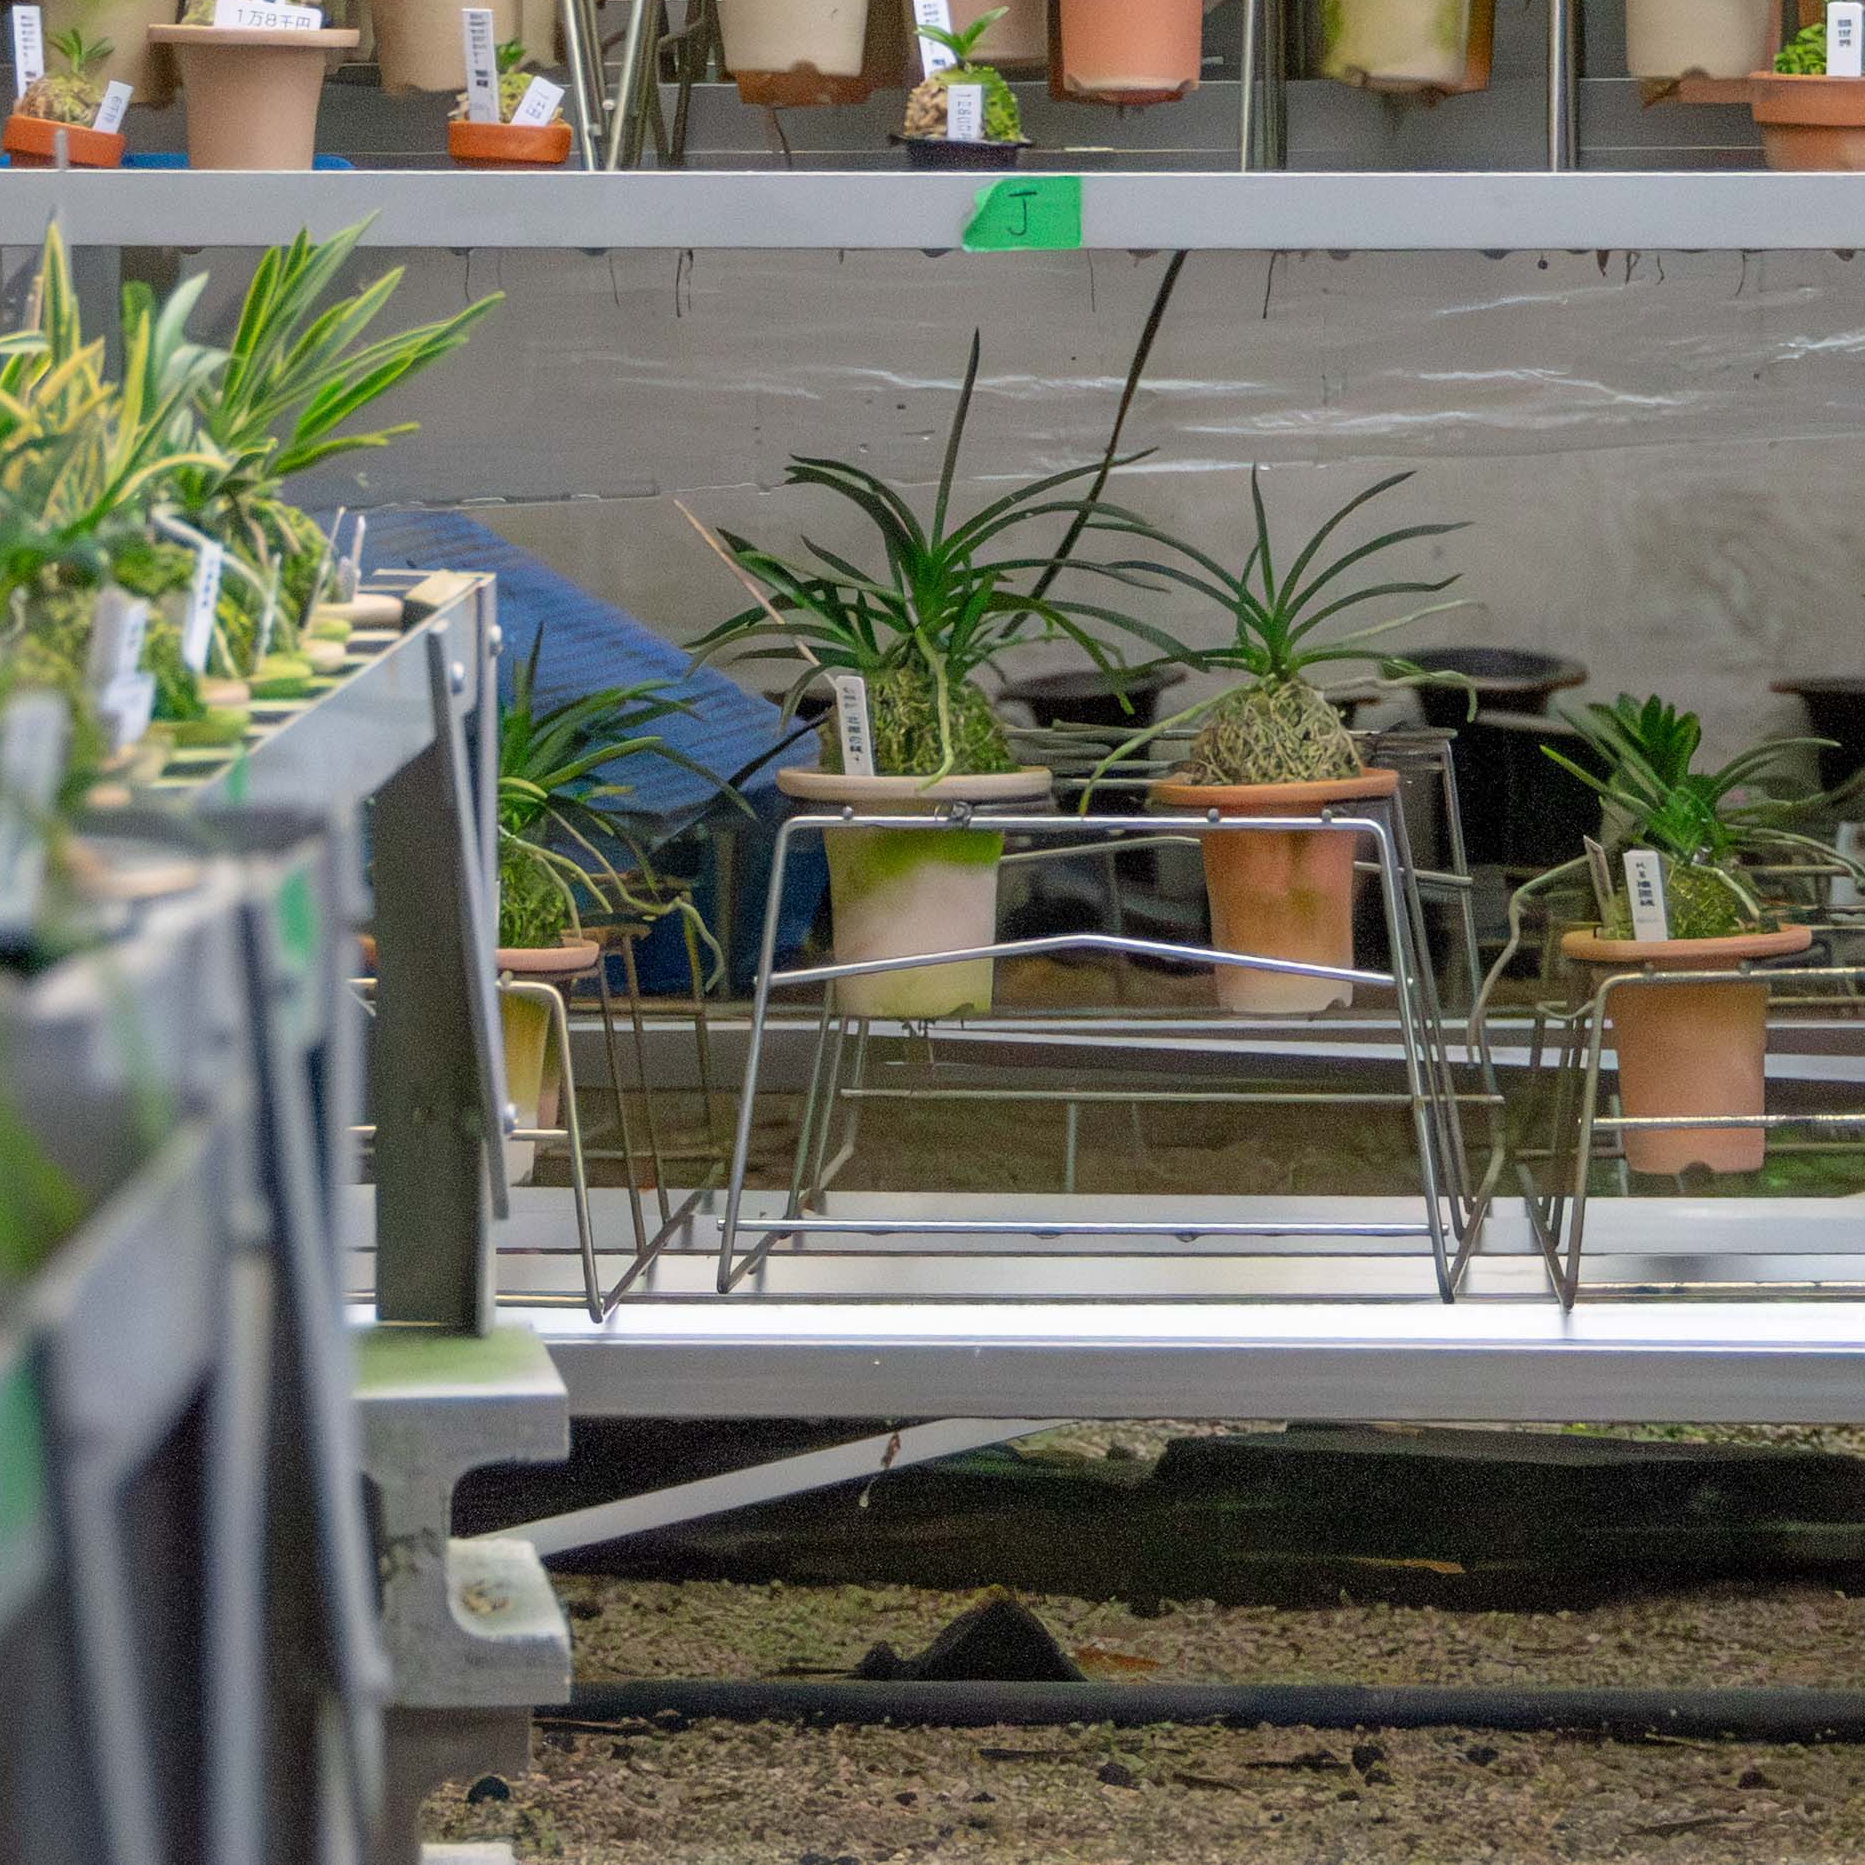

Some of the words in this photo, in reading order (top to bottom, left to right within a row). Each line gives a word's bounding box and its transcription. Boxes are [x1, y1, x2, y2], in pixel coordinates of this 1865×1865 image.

[237, 9, 311, 30] 1万8千円
[1008, 191, 1038, 238] J
